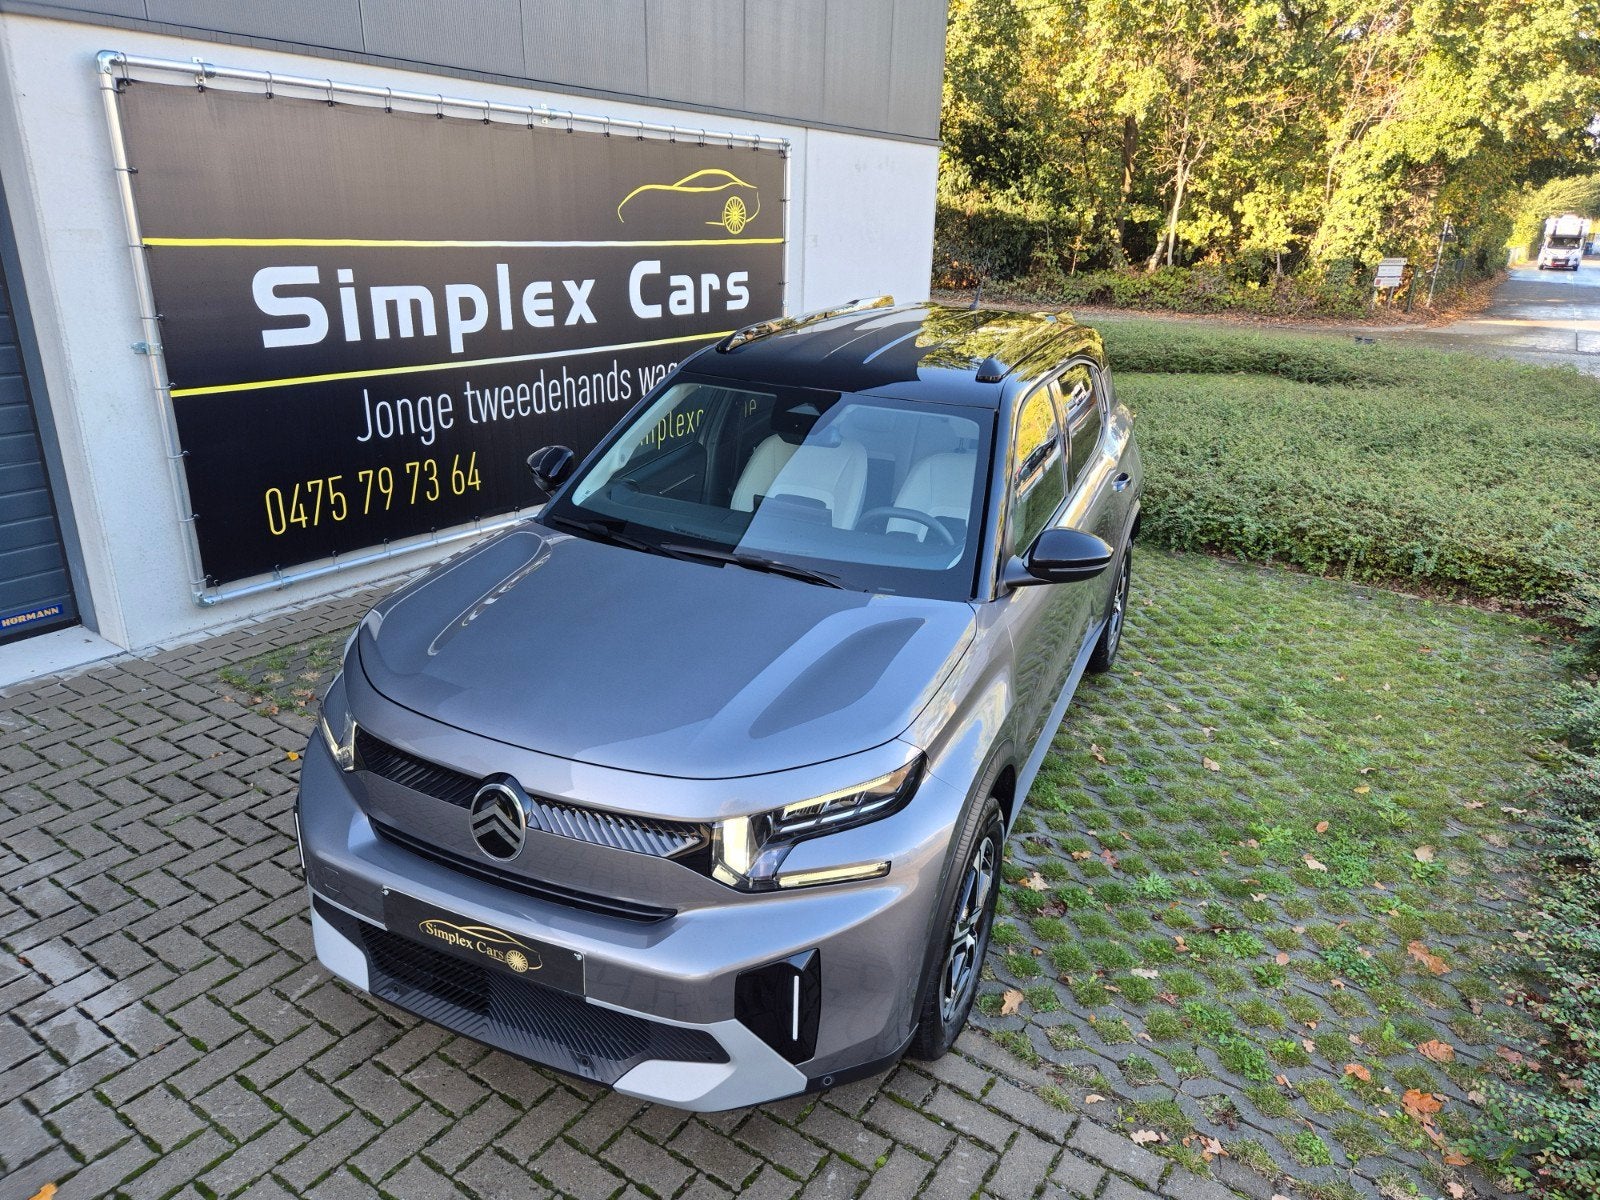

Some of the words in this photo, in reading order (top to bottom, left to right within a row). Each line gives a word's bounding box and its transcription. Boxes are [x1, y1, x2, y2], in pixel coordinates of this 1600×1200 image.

[251, 263, 598, 354] Simplex
[628, 259, 751, 319] Cars
[356, 388, 454, 446] Jonge
[463, 359, 632, 424] tweedehands
[265, 475, 347, 536] 0475
[358, 466, 395, 515] 79
[405, 458, 441, 505] 73
[451, 451, 482, 496] 64
[425, 922, 474, 951] Simplex
[476, 941, 505, 961] Cars
